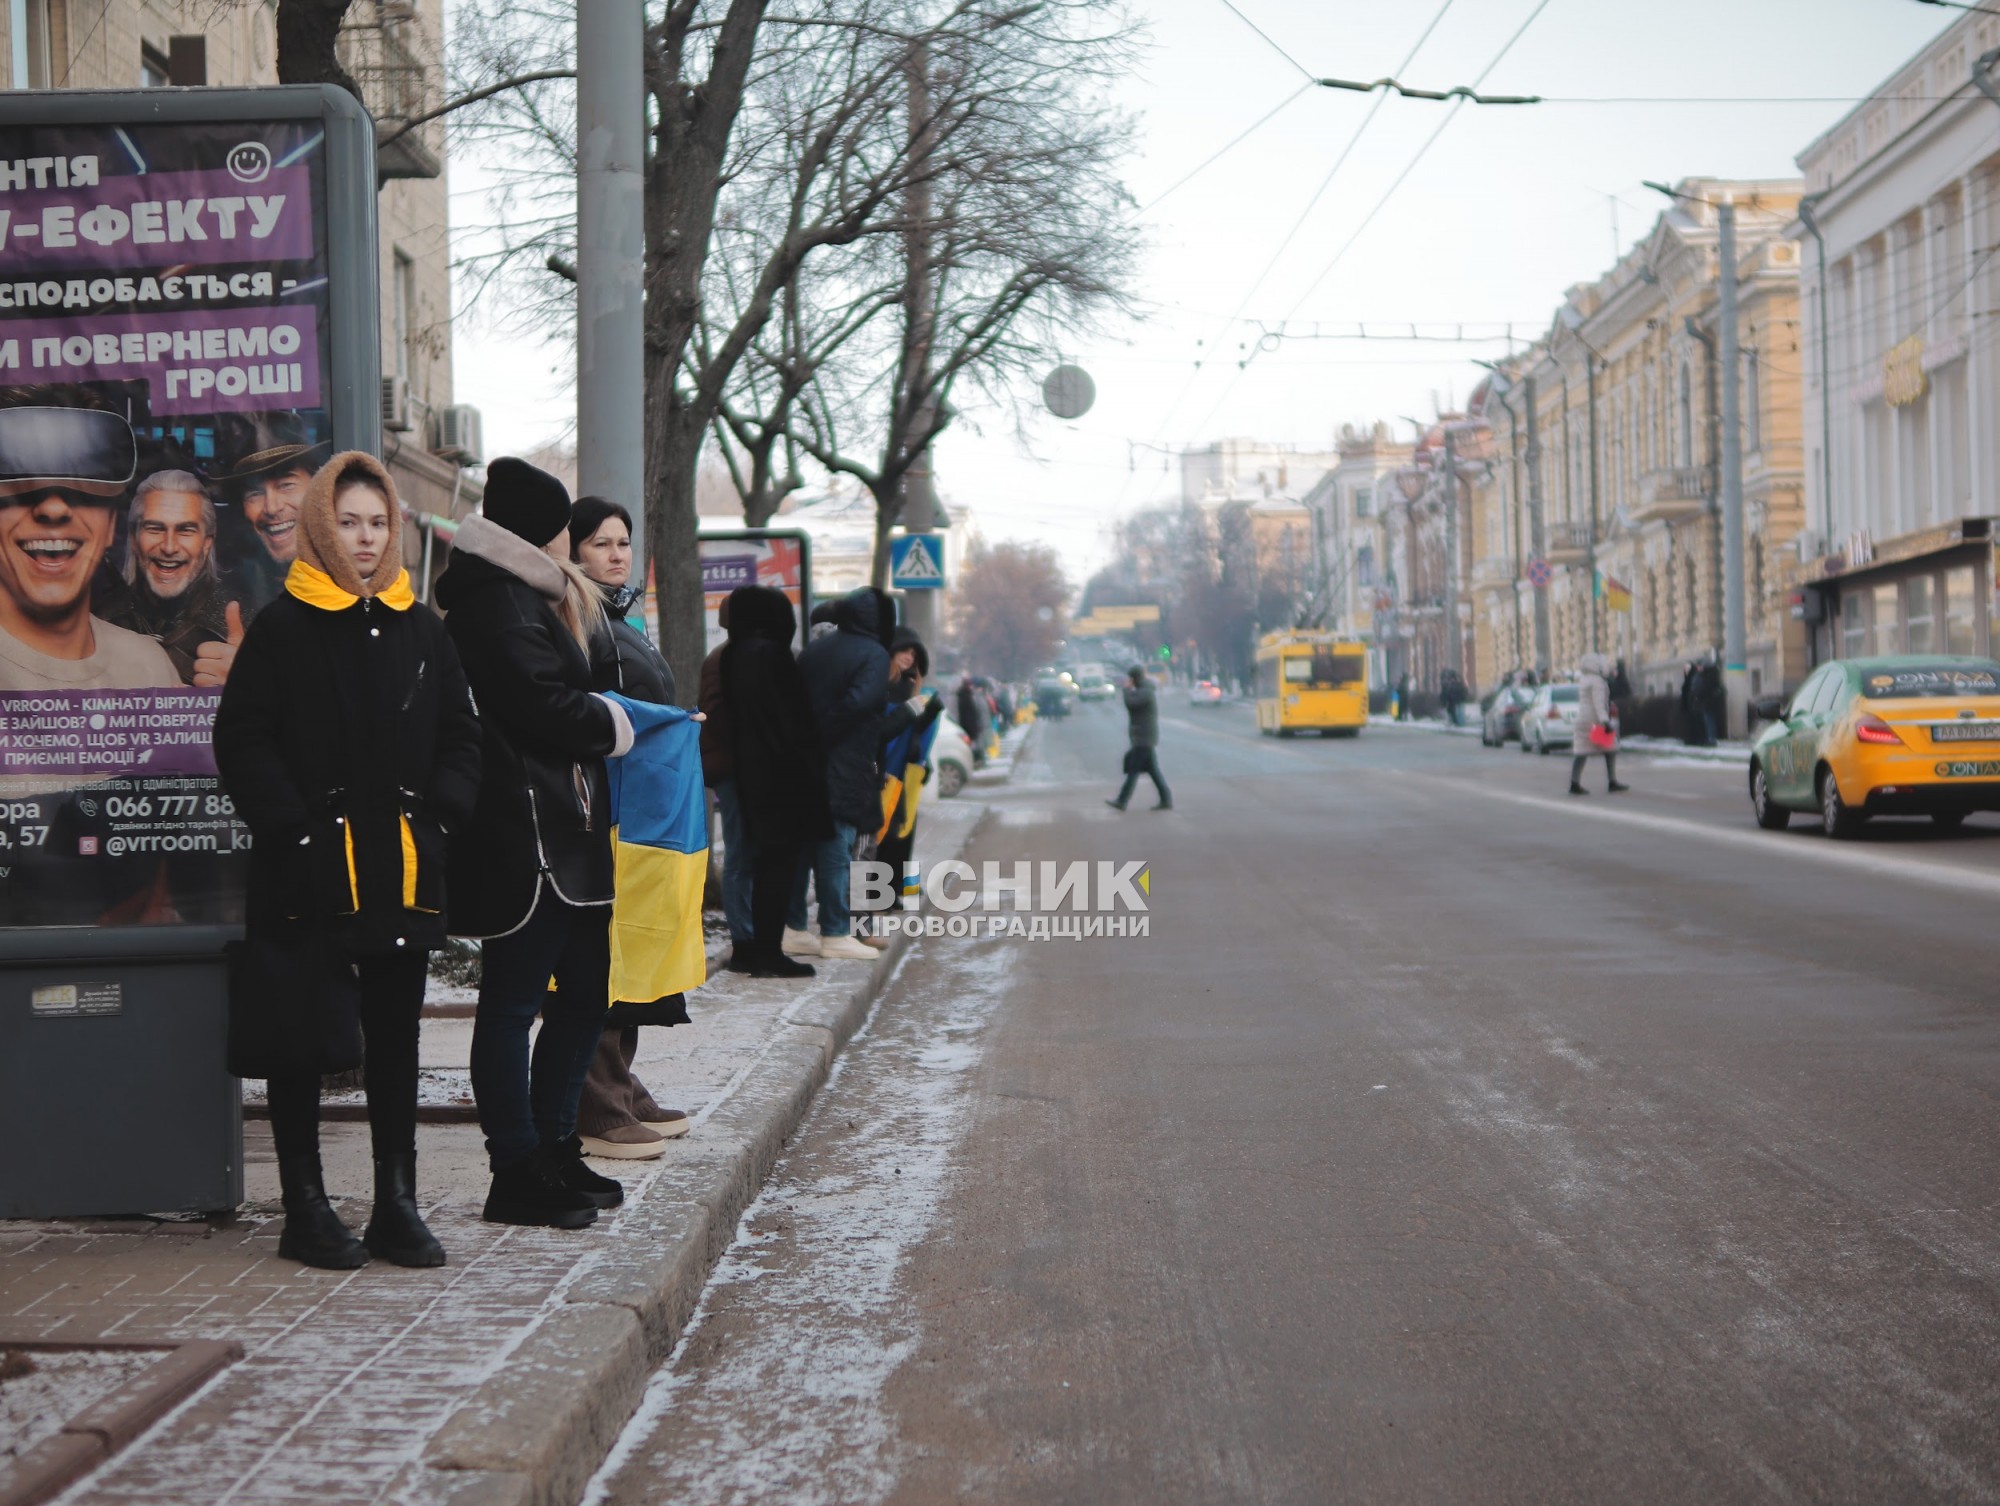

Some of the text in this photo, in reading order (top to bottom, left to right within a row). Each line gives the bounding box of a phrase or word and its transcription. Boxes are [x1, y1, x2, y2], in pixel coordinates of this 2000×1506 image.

[0, 155, 99, 192] НТІЯ
[0, 272, 273, 308] СПОДОБАЄТЬСЯ
[32, 325, 301, 368] ПОВЕРНЕМО
[165, 363, 302, 399] ГРОШІ
[2, 698, 70, 713] VRROOM
[82, 697, 153, 712] КІМНАТУ
[11, 714, 87, 730] ЗАЙШОВ?
[109, 715, 136, 728] МИ
[12, 734, 84, 749] ХОЧЕМО,
[87, 733, 126, 748] ЩОБ
[130, 732, 150, 745] VR
[153, 731, 213, 746] ЗАЛИШ
[4, 748, 135, 766] ПРИЄМНІ ЕМОЦІЇ
[142, 776, 218, 791] адміністратора
[105, 796, 152, 817] 066
[157, 796, 199, 816] 777
[187, 819, 229, 831] тарифів
[20, 825, 50, 846] 57
